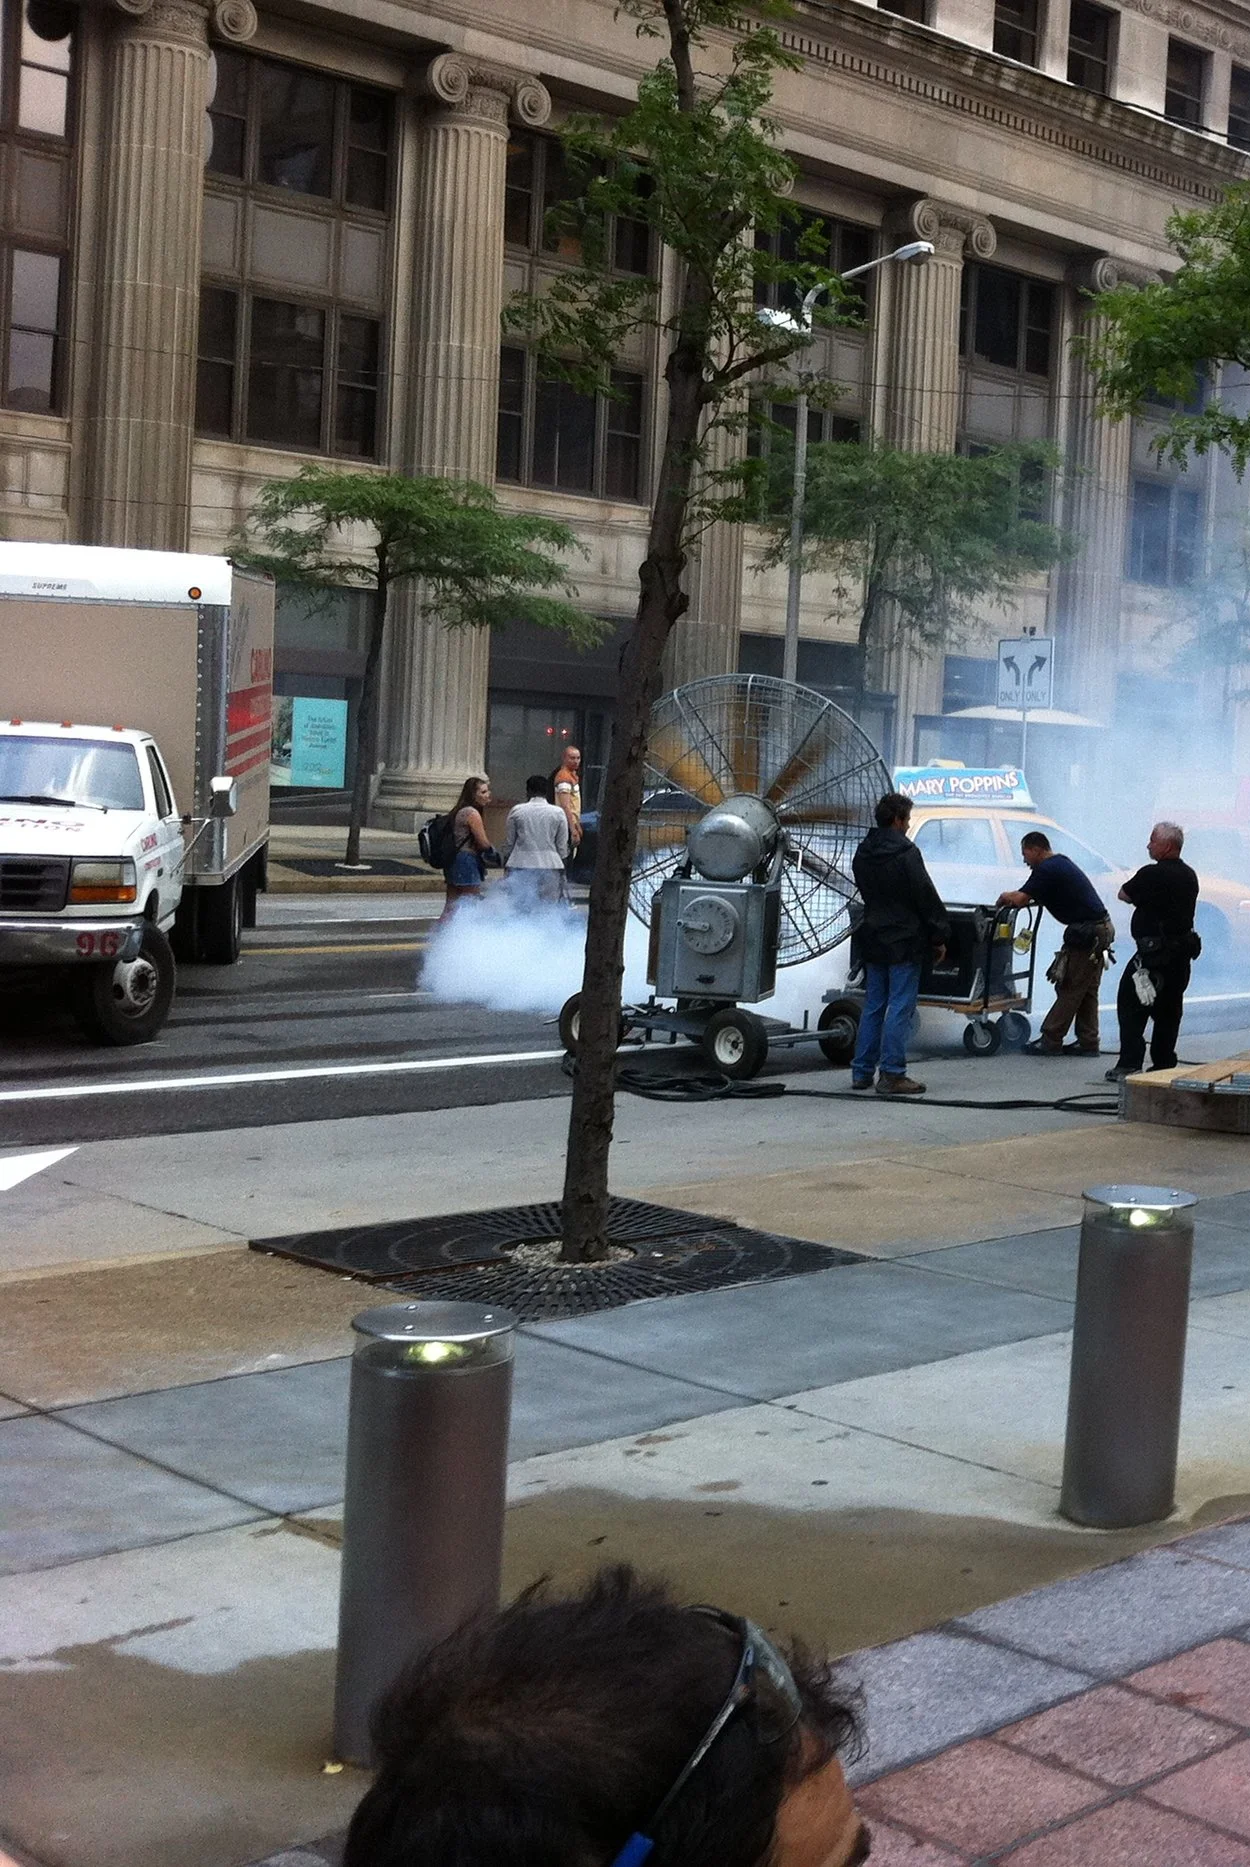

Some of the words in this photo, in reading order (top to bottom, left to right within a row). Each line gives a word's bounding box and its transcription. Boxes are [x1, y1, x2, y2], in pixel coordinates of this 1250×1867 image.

[32, 582, 68, 591] SUPREME
[1000, 691, 1020, 701] ONLY
[1026, 691, 1046, 701] ONLY
[899, 778, 945, 798] MARY
[949, 771, 1019, 794] POPPINS
